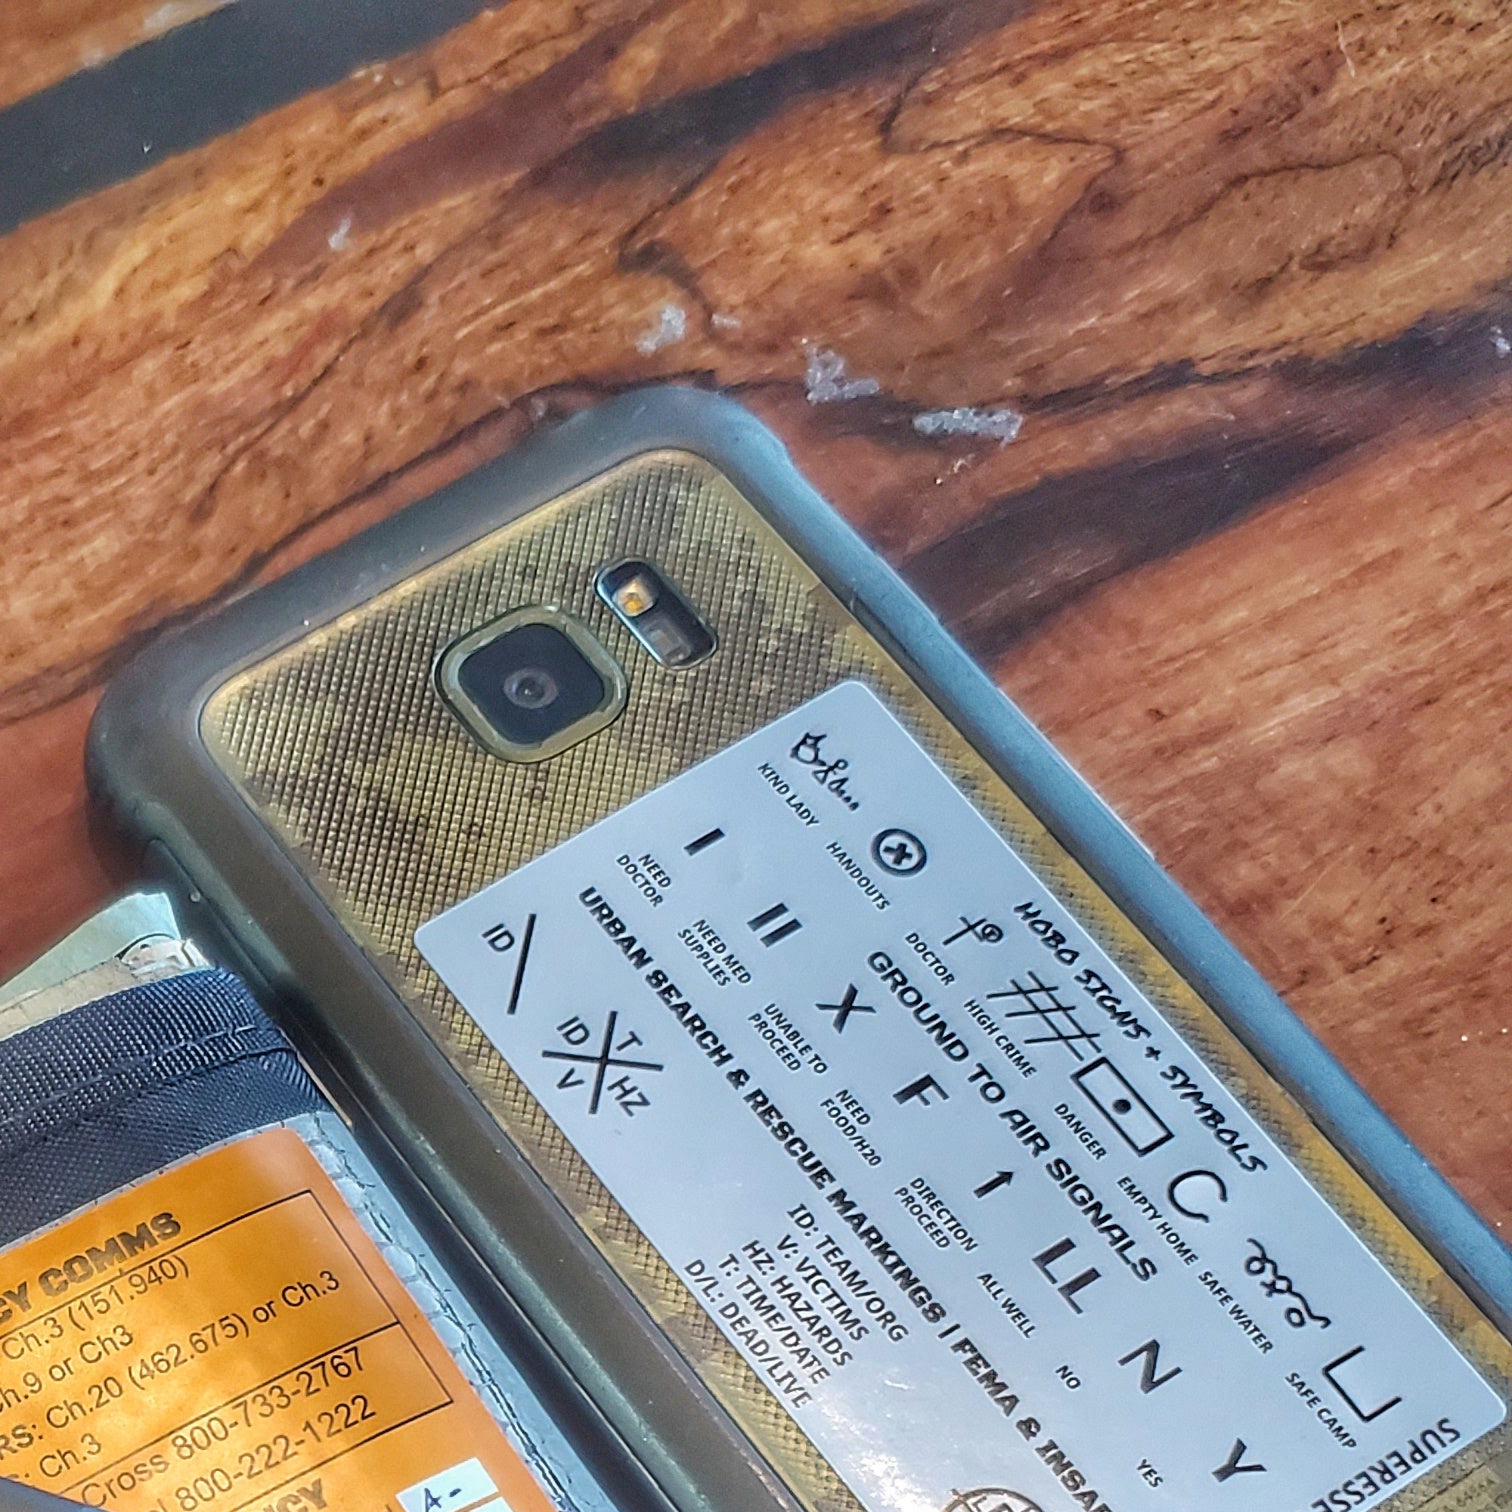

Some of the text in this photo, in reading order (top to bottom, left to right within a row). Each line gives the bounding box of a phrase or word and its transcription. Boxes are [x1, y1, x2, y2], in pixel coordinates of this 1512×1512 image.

[758, 763, 819, 826] KIND LADY
[617, 854, 663, 907] DOCTOR
[638, 853, 671, 888] NEED
[826, 842, 890, 910] HANDOUTS
[482, 923, 515, 952] ID
[678, 929, 730, 986] SUPPLIES
[693, 919, 751, 984] NEED MED
[906, 932, 955, 986] DOCTOR
[556, 1016, 590, 1045] ID
[764, 1003, 828, 1074] UNABLE TO
[816, 983, 876, 1034] X
[964, 1000, 1037, 1078] HIGH CRIME
[1014, 902, 1079, 966] HOBO
[1075, 969, 1151, 1039] SIGNS
[1161, 1065, 1268, 1172] SYMBOLS
[616, 1031, 643, 1052] T
[748, 1013, 801, 1072] PROCEED
[556, 1068, 585, 1090] V
[608, 1076, 651, 1117] HZ
[836, 1089, 871, 1126] NEED
[893, 1074, 949, 1105] F
[867, 952, 1157, 1281] GROUND TO AIR SIGNALS
[1055, 1104, 1106, 1160] DANGER
[579, 887, 653, 970] URBAN
[646, 970, 733, 1066] SEARCH
[727, 1069, 750, 1090] &
[743, 1088, 836, 1190] RESCUE
[826, 1188, 947, 1324] MARKINGS
[950, 1337, 1020, 1416] FEMA
[1015, 1416, 1041, 1441] &
[895, 1187, 950, 1249] PROCEED
[910, 1178, 978, 1252] DIRECTION
[1117, 1177, 1199, 1266] EMPTY HOME
[39, 1212, 181, 1297] COMMS
[786, 1203, 909, 1342] ID: TEAM/ORG
[2, 1317, 64, 1361] Ch.3
[68, 1256, 189, 1332] (151.940)
[718, 1253, 830, 1384] T: TIME/DATE
[742, 1240, 853, 1367] HZ: HAZARDS
[776, 1234, 869, 1342] V: VICTIMS
[977, 1274, 1038, 1338] ALL WELL
[1198, 1271, 1273, 1354] SAFE WATER
[46, 1377, 123, 1430] Ch.20
[128, 1312, 249, 1391] (462.675)
[253, 1298, 278, 1324] or
[282, 1269, 341, 1309] Ch.3
[49, 1357, 76, 1381] or
[79, 1325, 134, 1364] Ch3
[684, 1259, 813, 1410] D/L: DEAD/LIVE
[1118, 1338, 1183, 1394] N
[1055, 1365, 1080, 1390] NO
[81, 1347, 365, 1508] Cross 800-733-2767
[1286, 1372, 1356, 1449] SAFE CAMP
[40, 1433, 101, 1477] Ch.3
[175, 1395, 376, 1512] 800-222-1222
[1136, 1459, 1164, 1488] YES
[1212, 1437, 1267, 1483] Y
